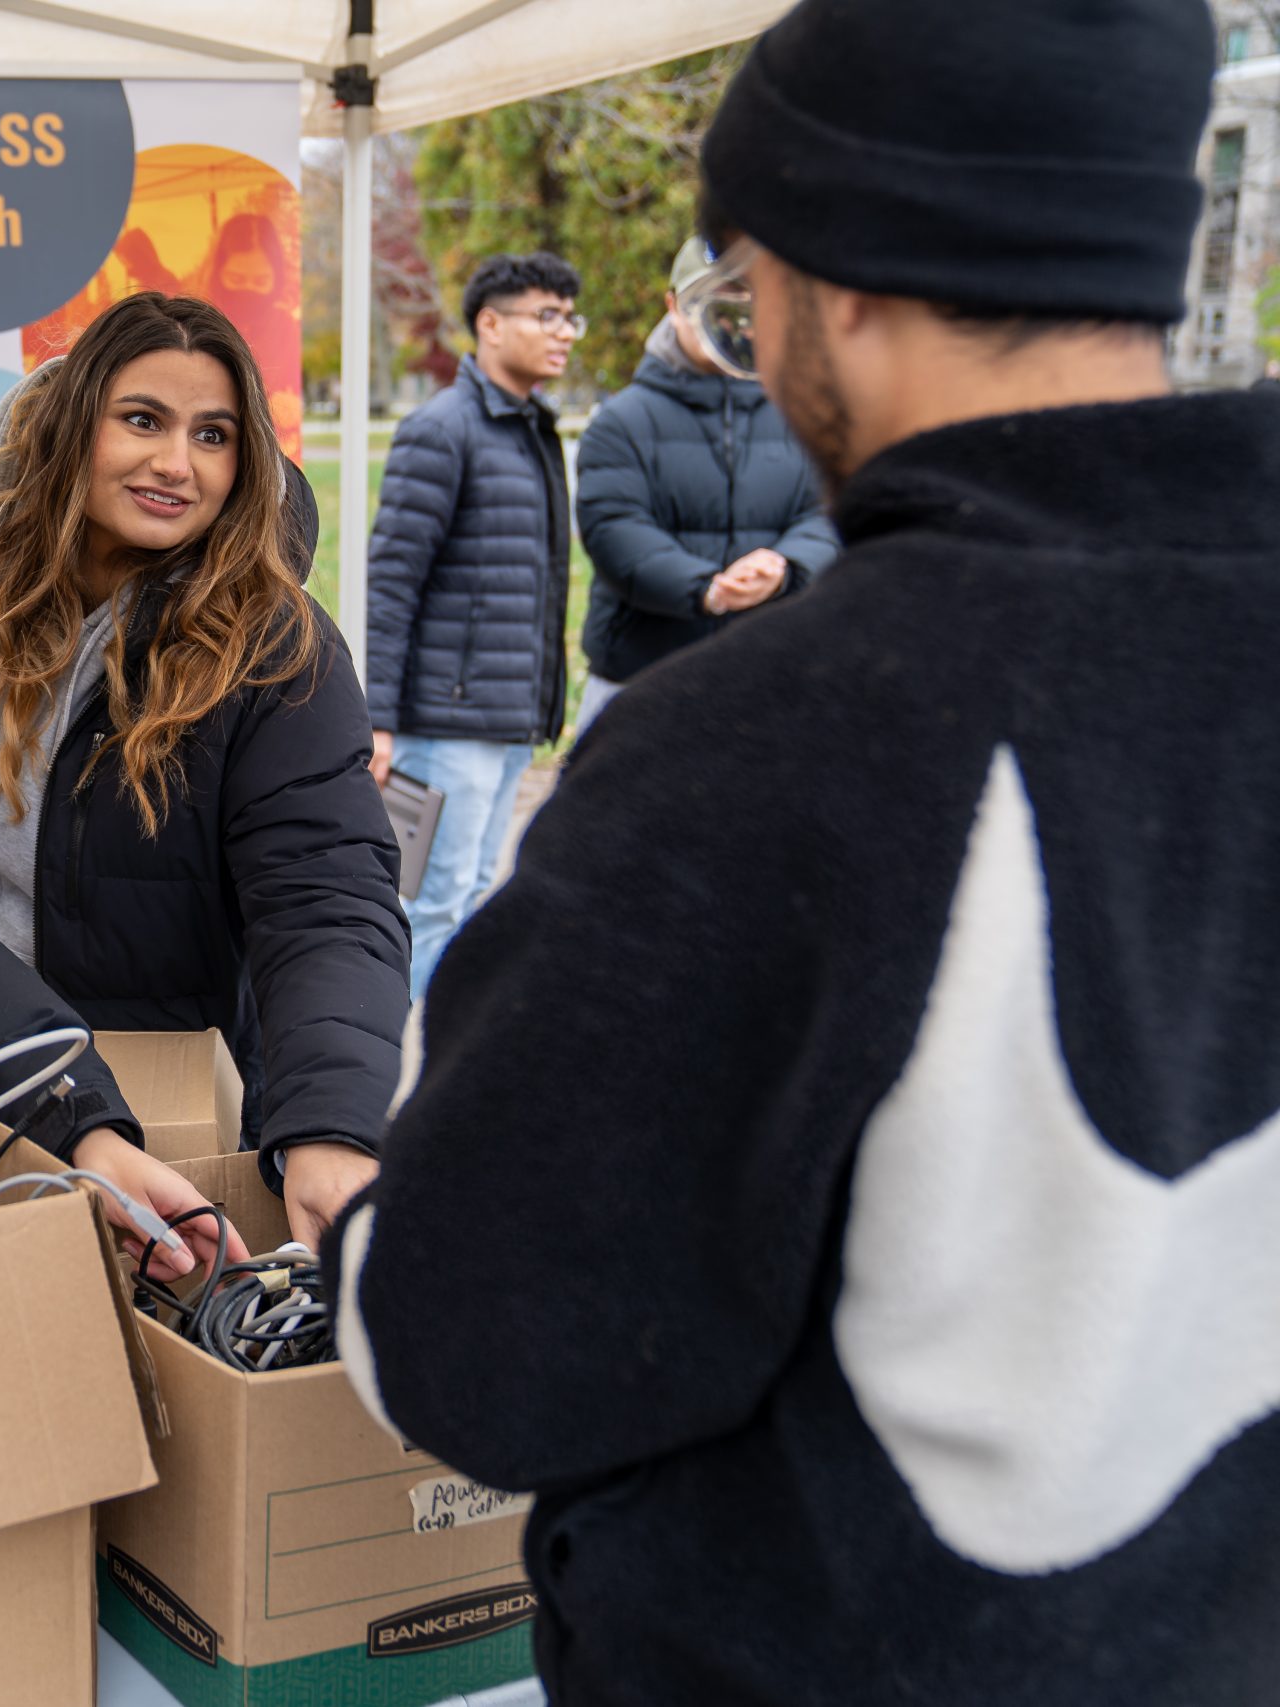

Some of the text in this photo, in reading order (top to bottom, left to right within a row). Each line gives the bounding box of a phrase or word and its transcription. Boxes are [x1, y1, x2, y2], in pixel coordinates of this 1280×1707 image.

[113, 1559, 211, 1654] BANKERS BOX
[378, 1593, 539, 1647] BANKERS BOX
